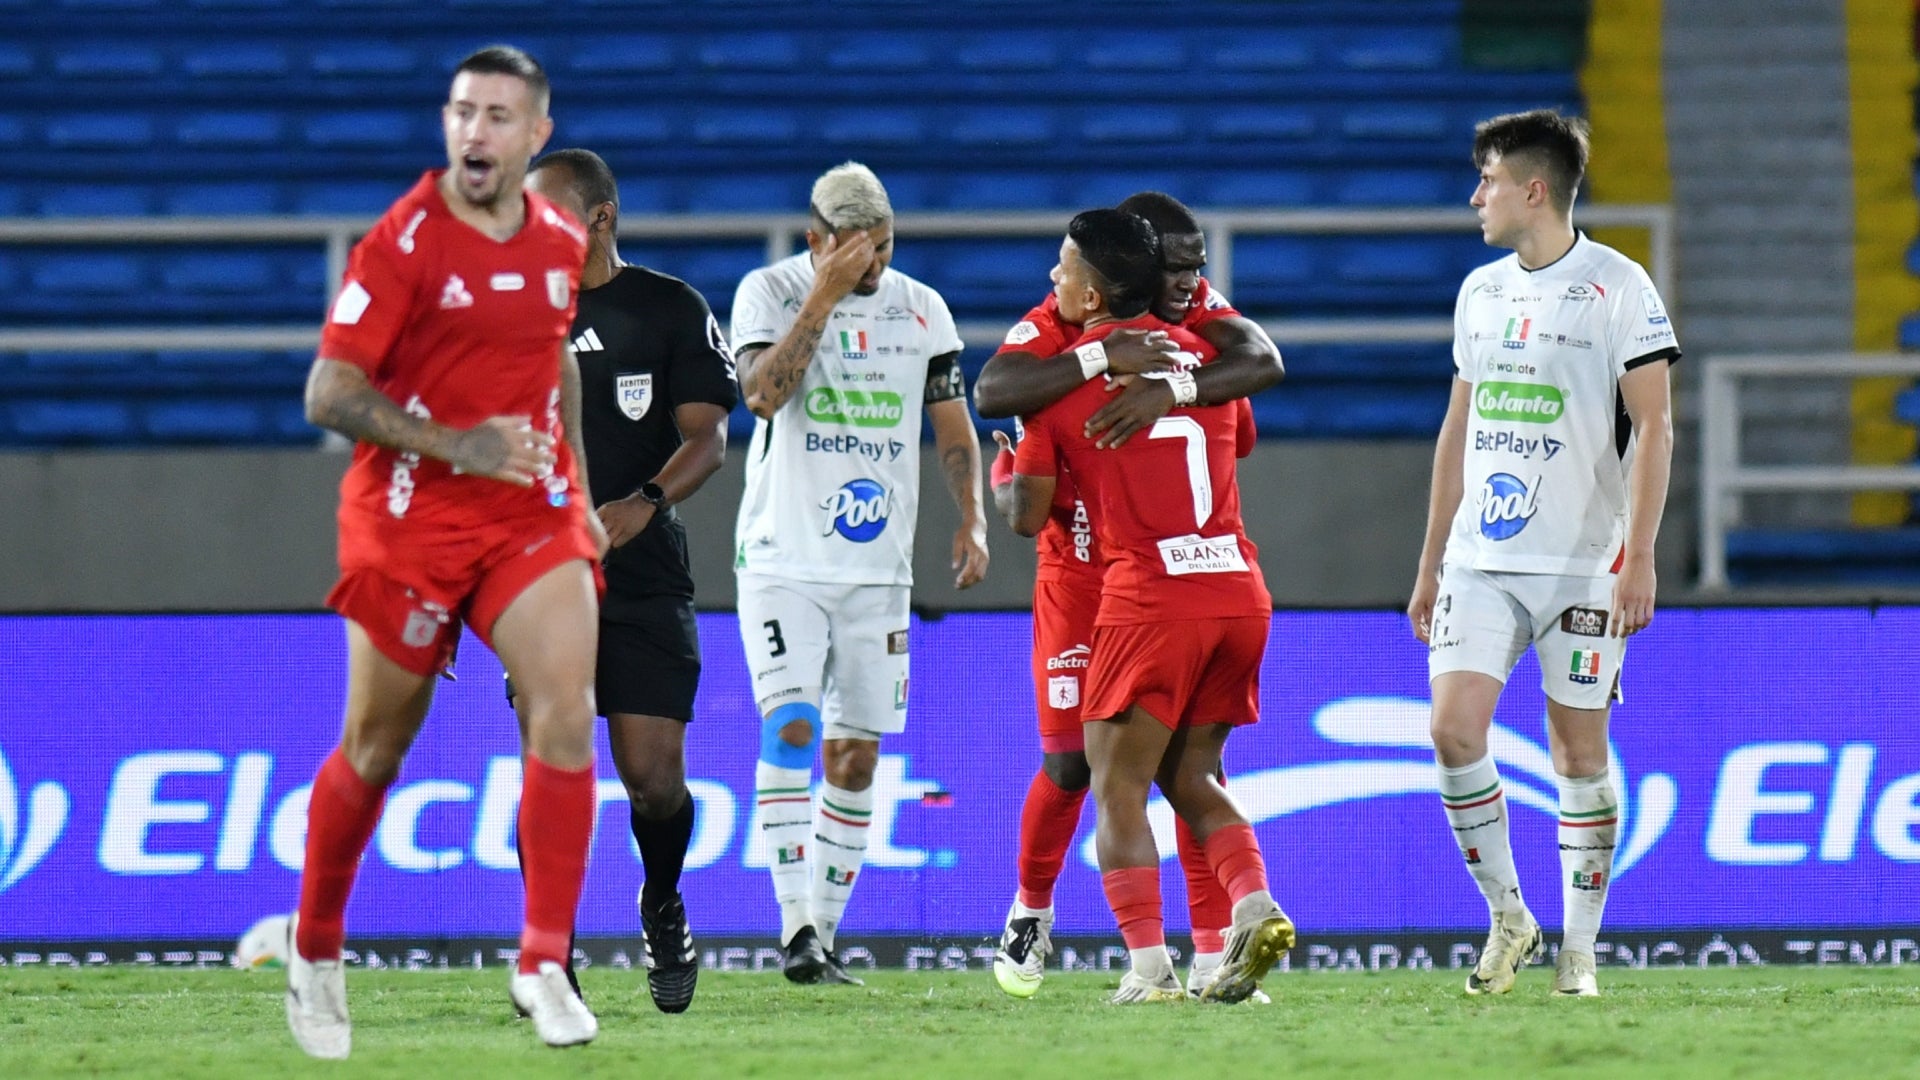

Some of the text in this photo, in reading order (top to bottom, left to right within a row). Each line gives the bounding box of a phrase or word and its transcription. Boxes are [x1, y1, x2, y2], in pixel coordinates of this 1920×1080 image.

[624, 388, 645, 401] FCF
[807, 391, 900, 420] Colanta
[1477, 387, 1561, 415] Colanta
[806, 433, 884, 462] BetPay
[1475, 430, 1539, 459] BetPlay
[1148, 416, 1213, 529] 7
[818, 482, 894, 537] Pool
[763, 619, 787, 658] 3
